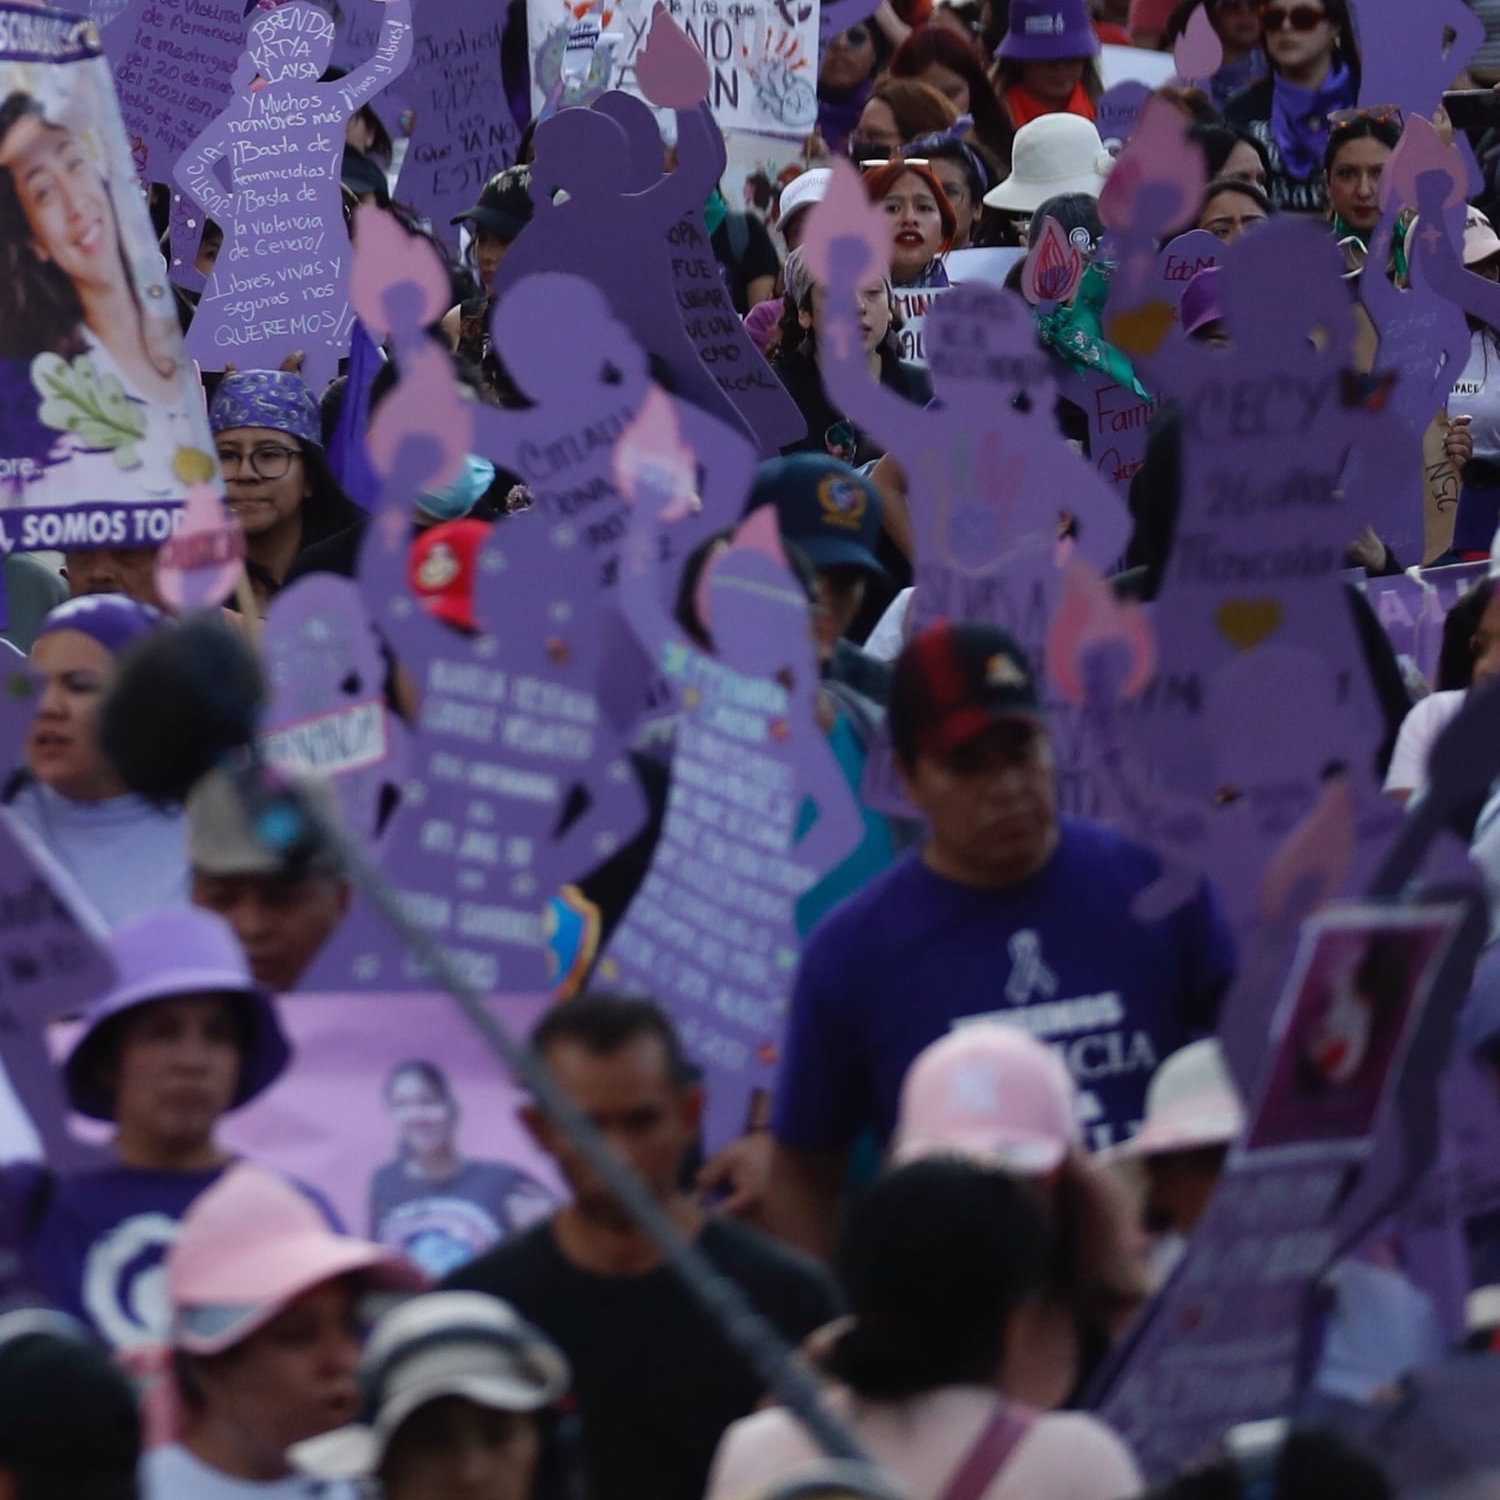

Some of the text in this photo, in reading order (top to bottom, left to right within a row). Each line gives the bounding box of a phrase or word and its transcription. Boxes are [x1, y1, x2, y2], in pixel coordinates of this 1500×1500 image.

[252, 7, 336, 46] BRENDA
[248, 38, 311, 69] KATYA
[265, 62, 320, 85] LAYSA
[259, 91, 322, 113] Muchos
[227, 106, 342, 133] nombres más
[307, 137, 332, 152] de
[297, 187, 317, 202] de
[233, 214, 323, 236] la violencia
[229, 243, 249, 261] de
[280, 262, 324, 283] vivas
[224, 284, 335, 322] seguras nos
[22, 510, 120, 546] SOMOS
